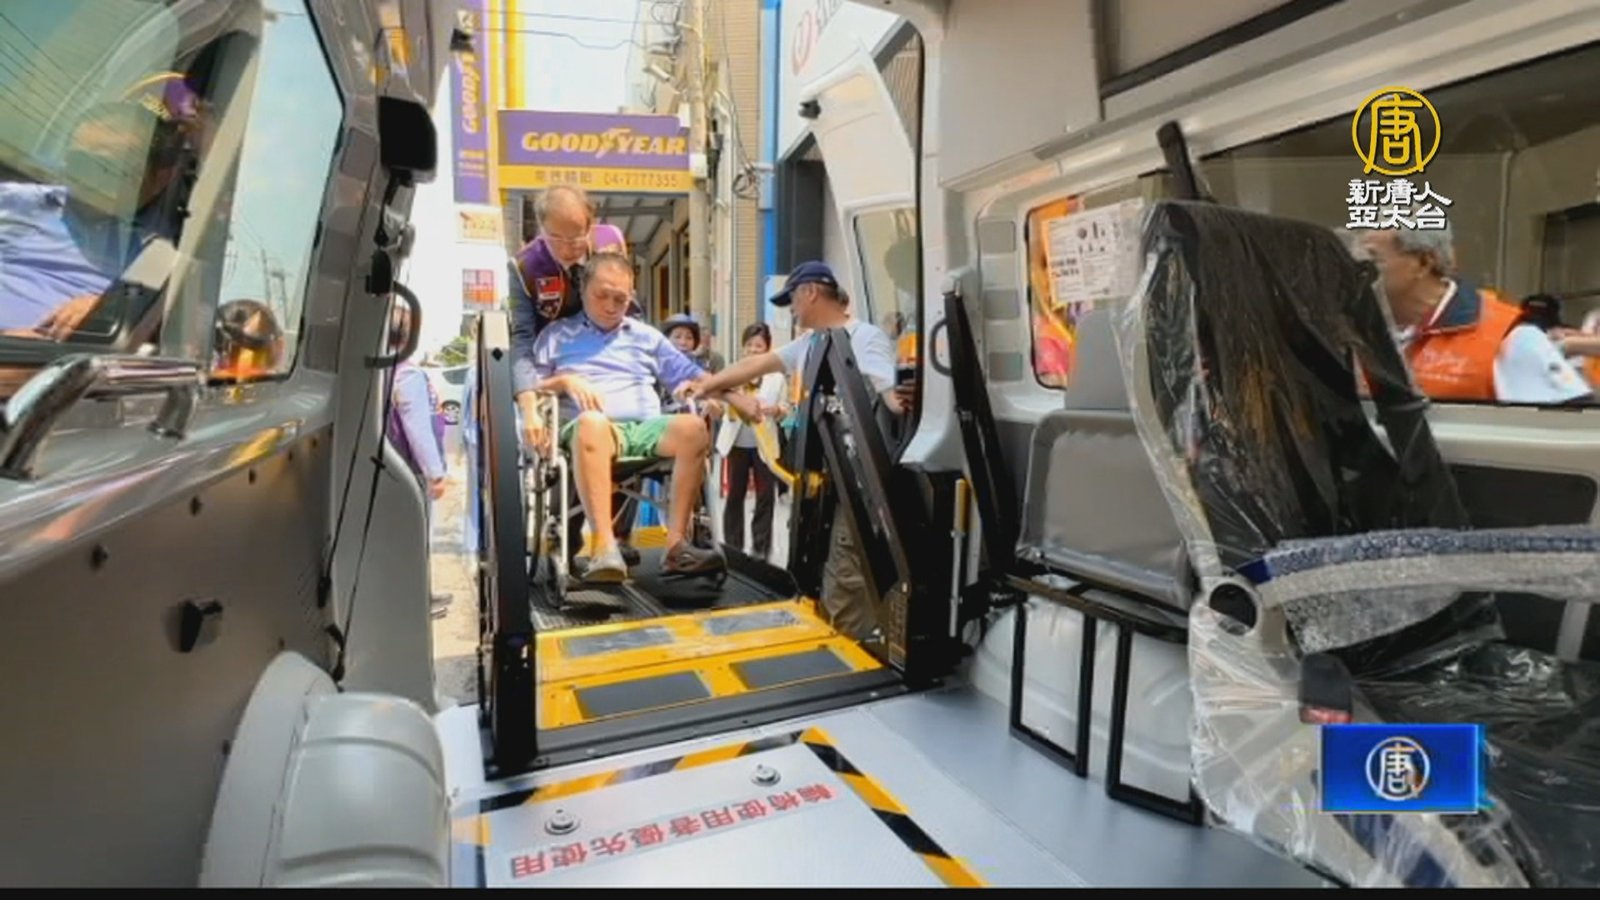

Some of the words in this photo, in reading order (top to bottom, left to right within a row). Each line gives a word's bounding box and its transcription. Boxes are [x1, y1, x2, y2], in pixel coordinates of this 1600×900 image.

[521, 128, 686, 157] GOODYEAR
[511, 785, 834, 878] 輪椅使用者優先使用
